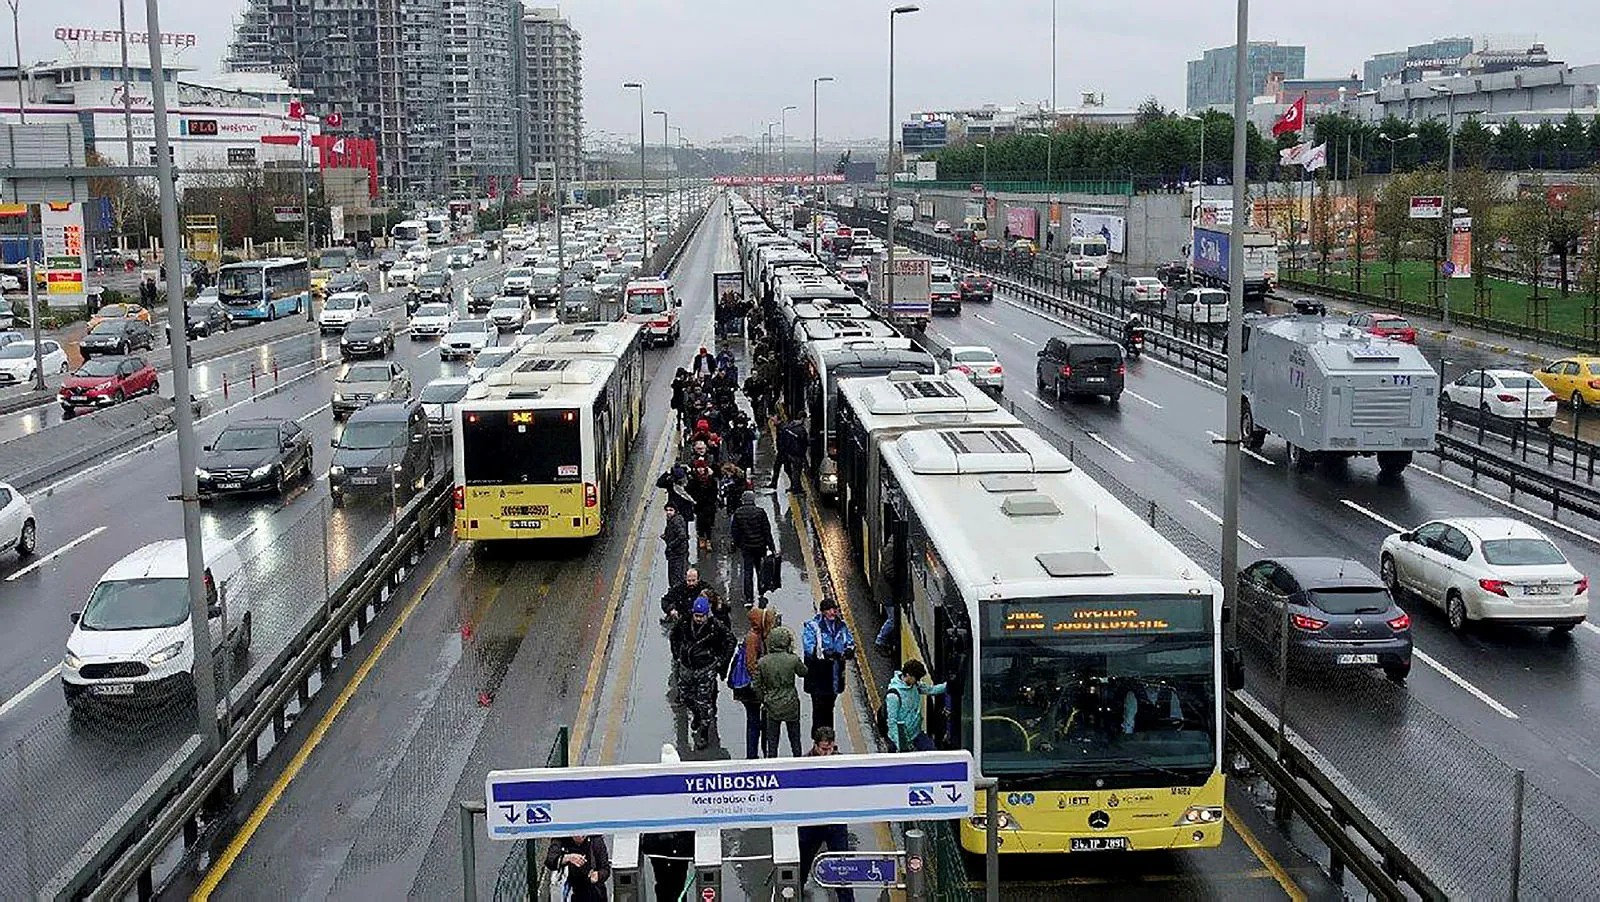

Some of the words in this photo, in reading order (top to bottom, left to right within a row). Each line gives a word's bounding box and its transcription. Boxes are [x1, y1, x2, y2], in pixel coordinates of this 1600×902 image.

[54, 27, 125, 42] OUTLET
[189, 122, 216, 132] FLO
[1392, 375, 1411, 386] T71
[685, 774, 780, 792] YENİBOSNA
